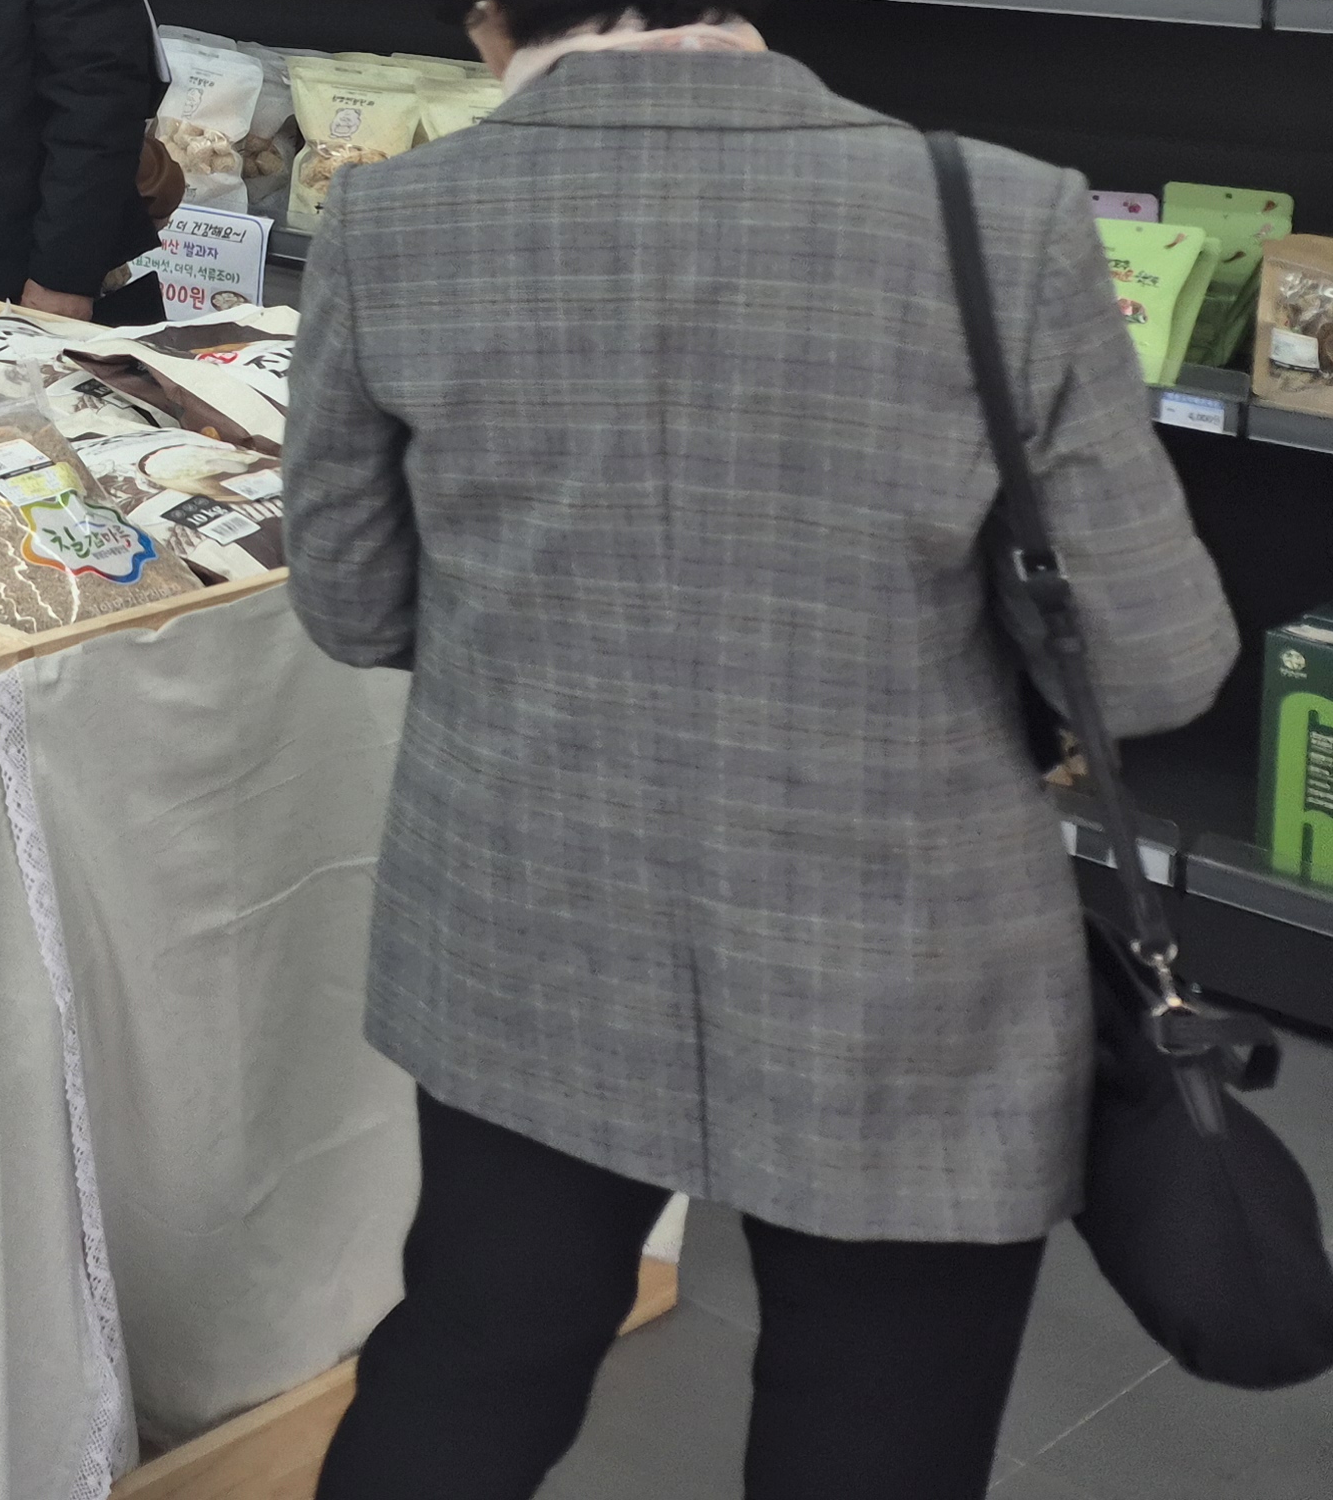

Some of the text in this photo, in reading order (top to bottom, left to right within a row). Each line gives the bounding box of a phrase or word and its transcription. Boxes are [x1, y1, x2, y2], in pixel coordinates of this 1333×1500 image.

[176, 220, 188, 232] 더
[191, 221, 247, 243] 건강해요~!
[183, 241, 219, 260] 쌀과자
[40, 523, 133, 560] 칠갑마루
